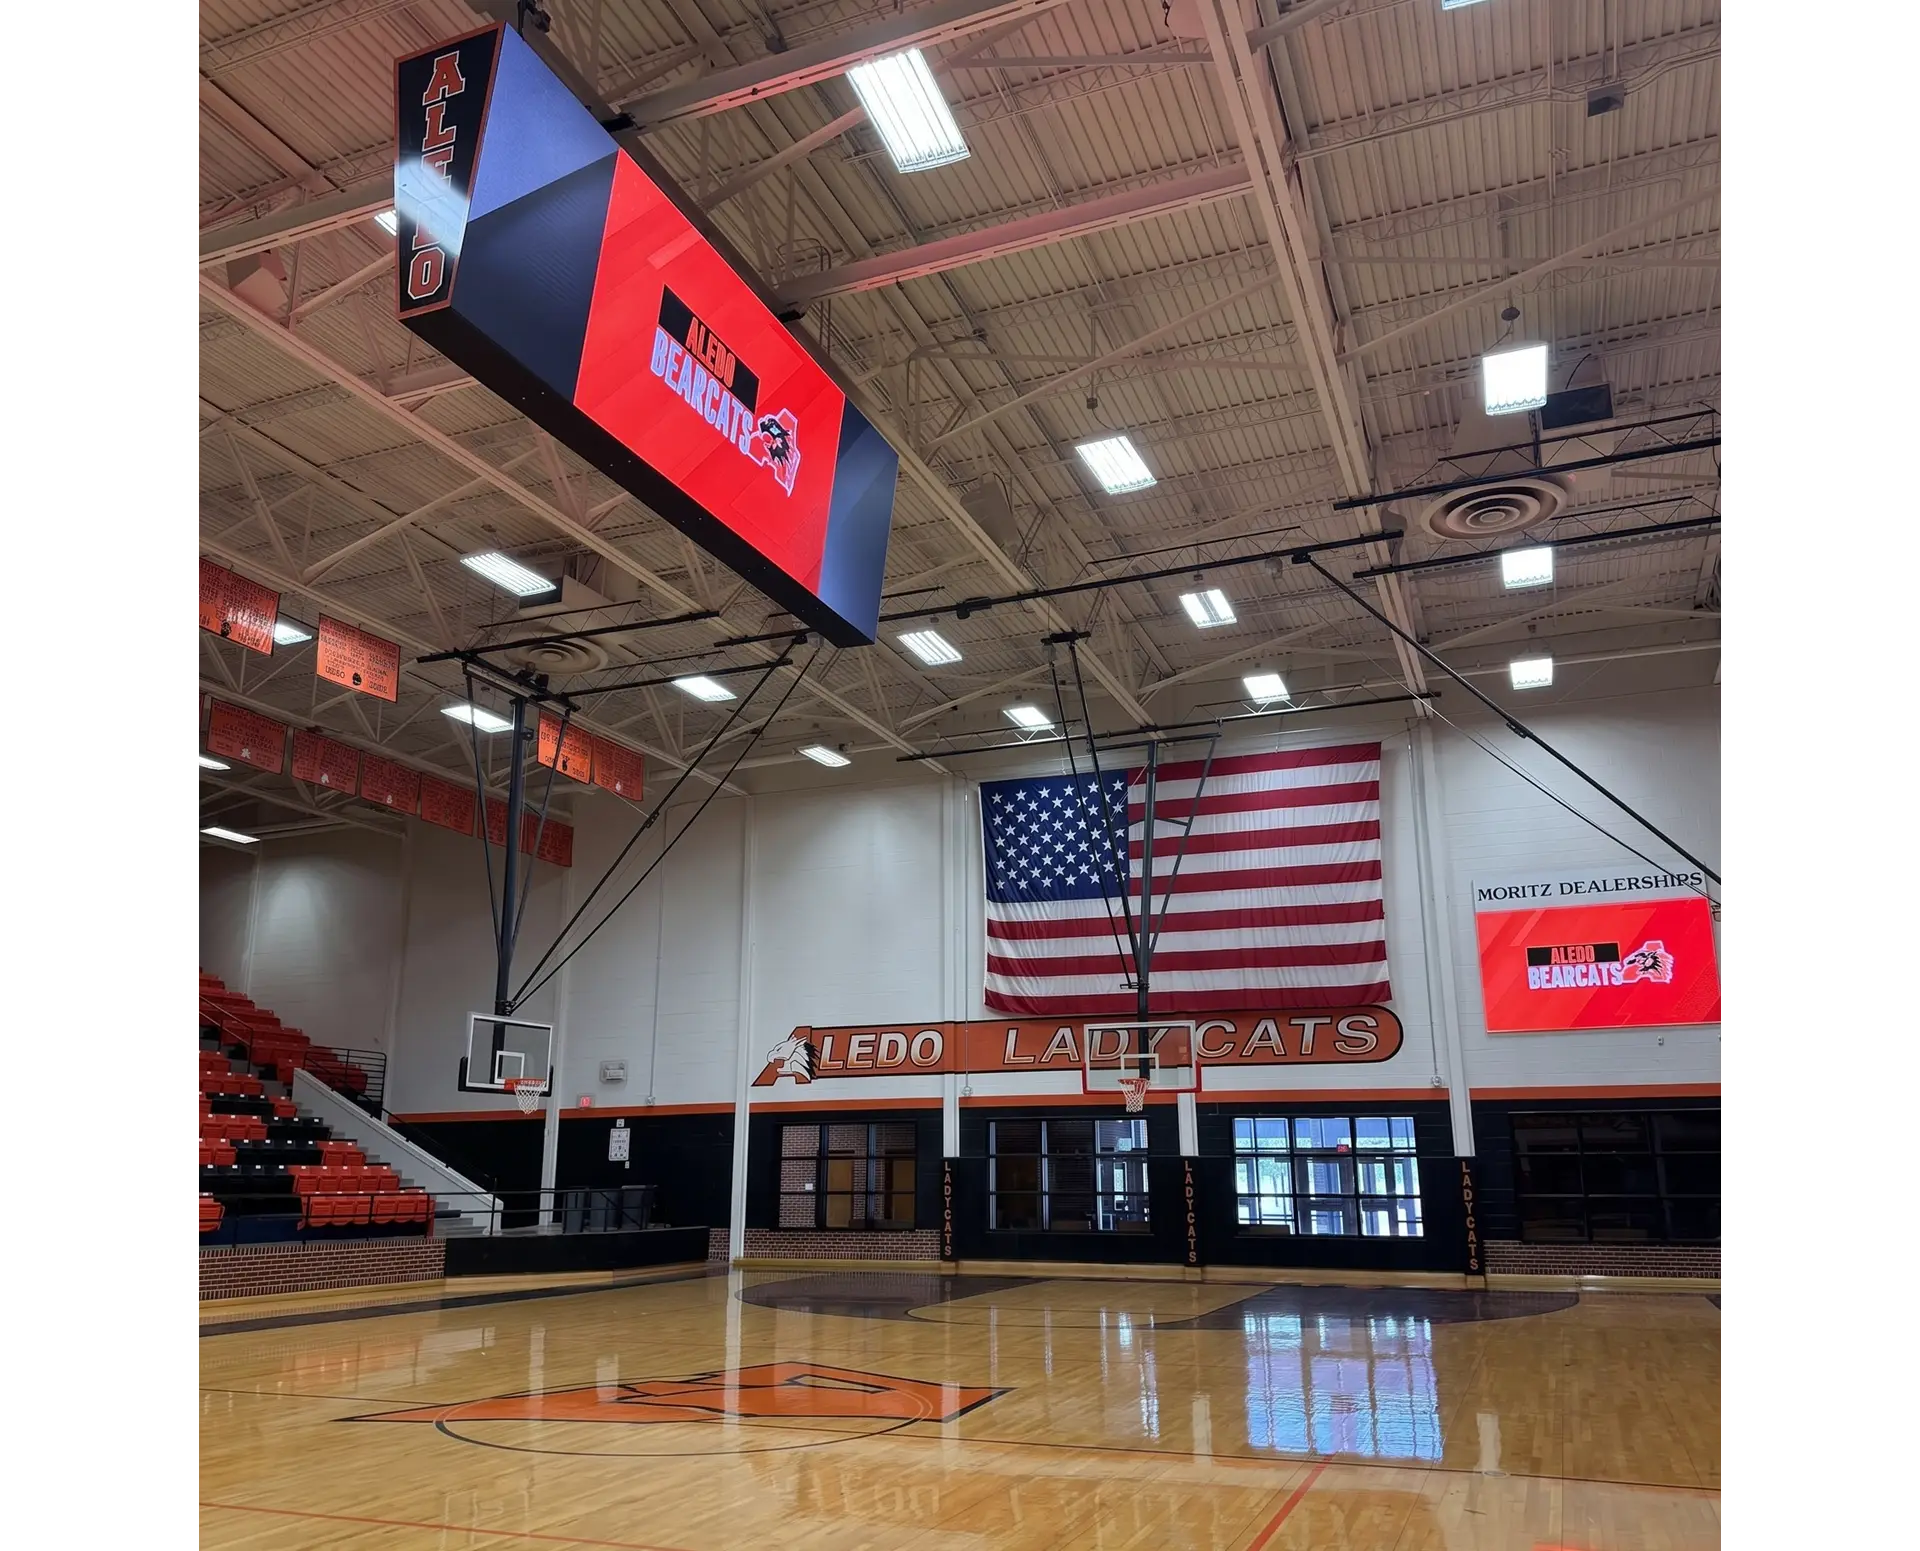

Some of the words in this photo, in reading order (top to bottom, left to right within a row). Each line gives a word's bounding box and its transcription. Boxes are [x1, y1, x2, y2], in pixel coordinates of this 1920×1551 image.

[685, 316, 736, 388] ALEDO
[650, 327, 754, 456] BEARCATS
[1478, 883, 1552, 901] MORITZ
[1559, 872, 1703, 896] DEALERSHIPS
[1528, 961, 1624, 990] BEARCATS
[1550, 945, 1595, 965] ALEDO
[1195, 1013, 1380, 1059] CATS
[944, 1161, 952, 1256] LADYCATS
[1184, 1160, 1197, 1263] LADYCATS
[1461, 1161, 1479, 1270] LADYCATS
